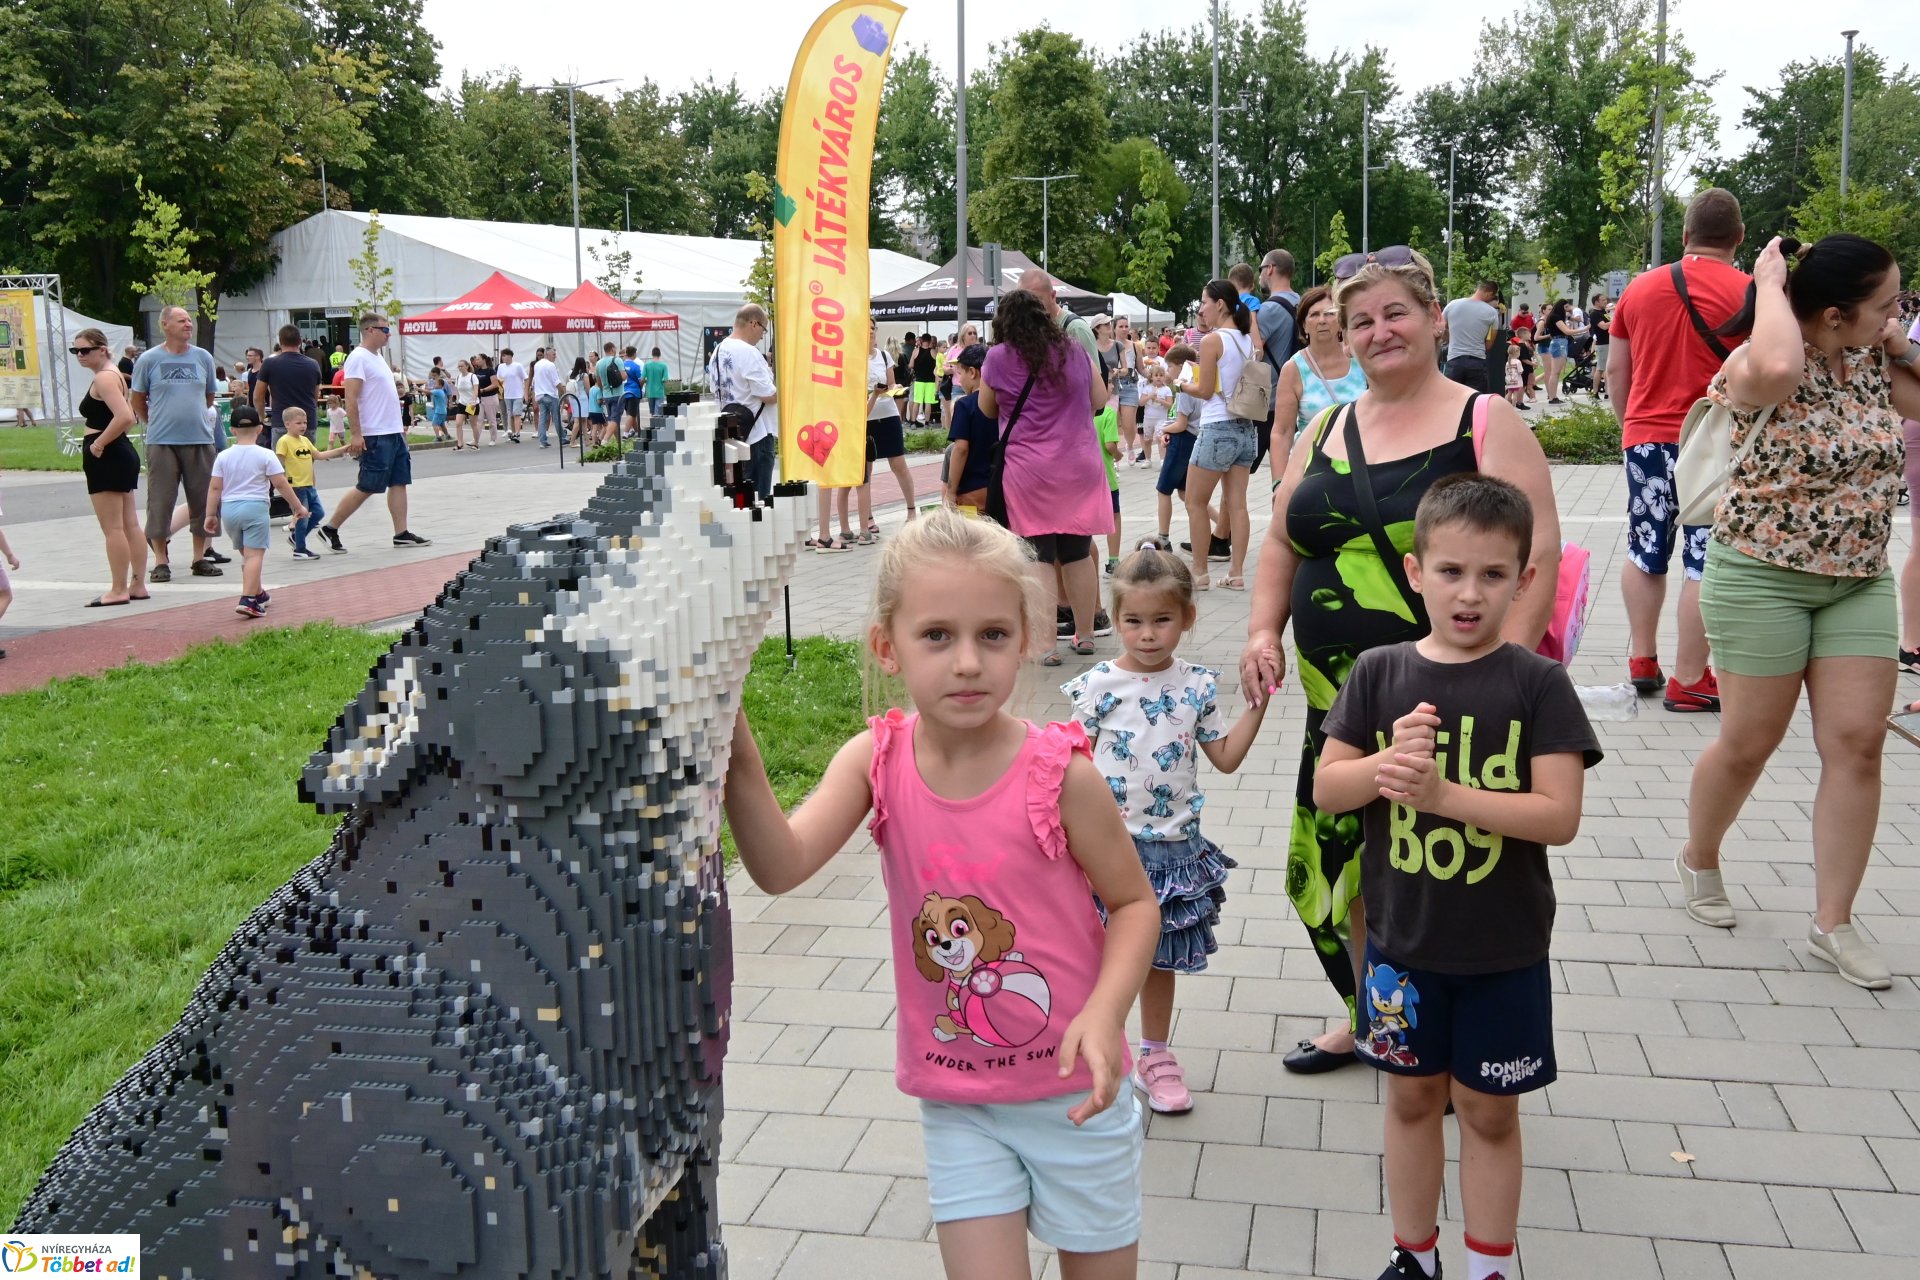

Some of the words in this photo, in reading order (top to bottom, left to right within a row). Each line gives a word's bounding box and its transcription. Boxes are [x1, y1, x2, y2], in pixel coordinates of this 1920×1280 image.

[803, 54, 864, 275] JÁTÉKVÁROS
[441, 302, 494, 312] MOTUL
[510, 301, 556, 311] MOTUL
[403, 321, 438, 333] MOTUL
[466, 319, 503, 331] MOTUL
[511, 319, 543, 330] MOTUL
[566, 319, 595, 329] MOTUL
[603, 320, 631, 330] MOTUL
[651, 319, 676, 329] MOTUL
[925, 1051, 976, 1071] UNDER
[984, 1054, 1016, 1069] THE
[1026, 1045, 1056, 1061] SUN
[1480, 1056, 1531, 1077] SONIC
[1501, 1056, 1543, 1088] PRIME
